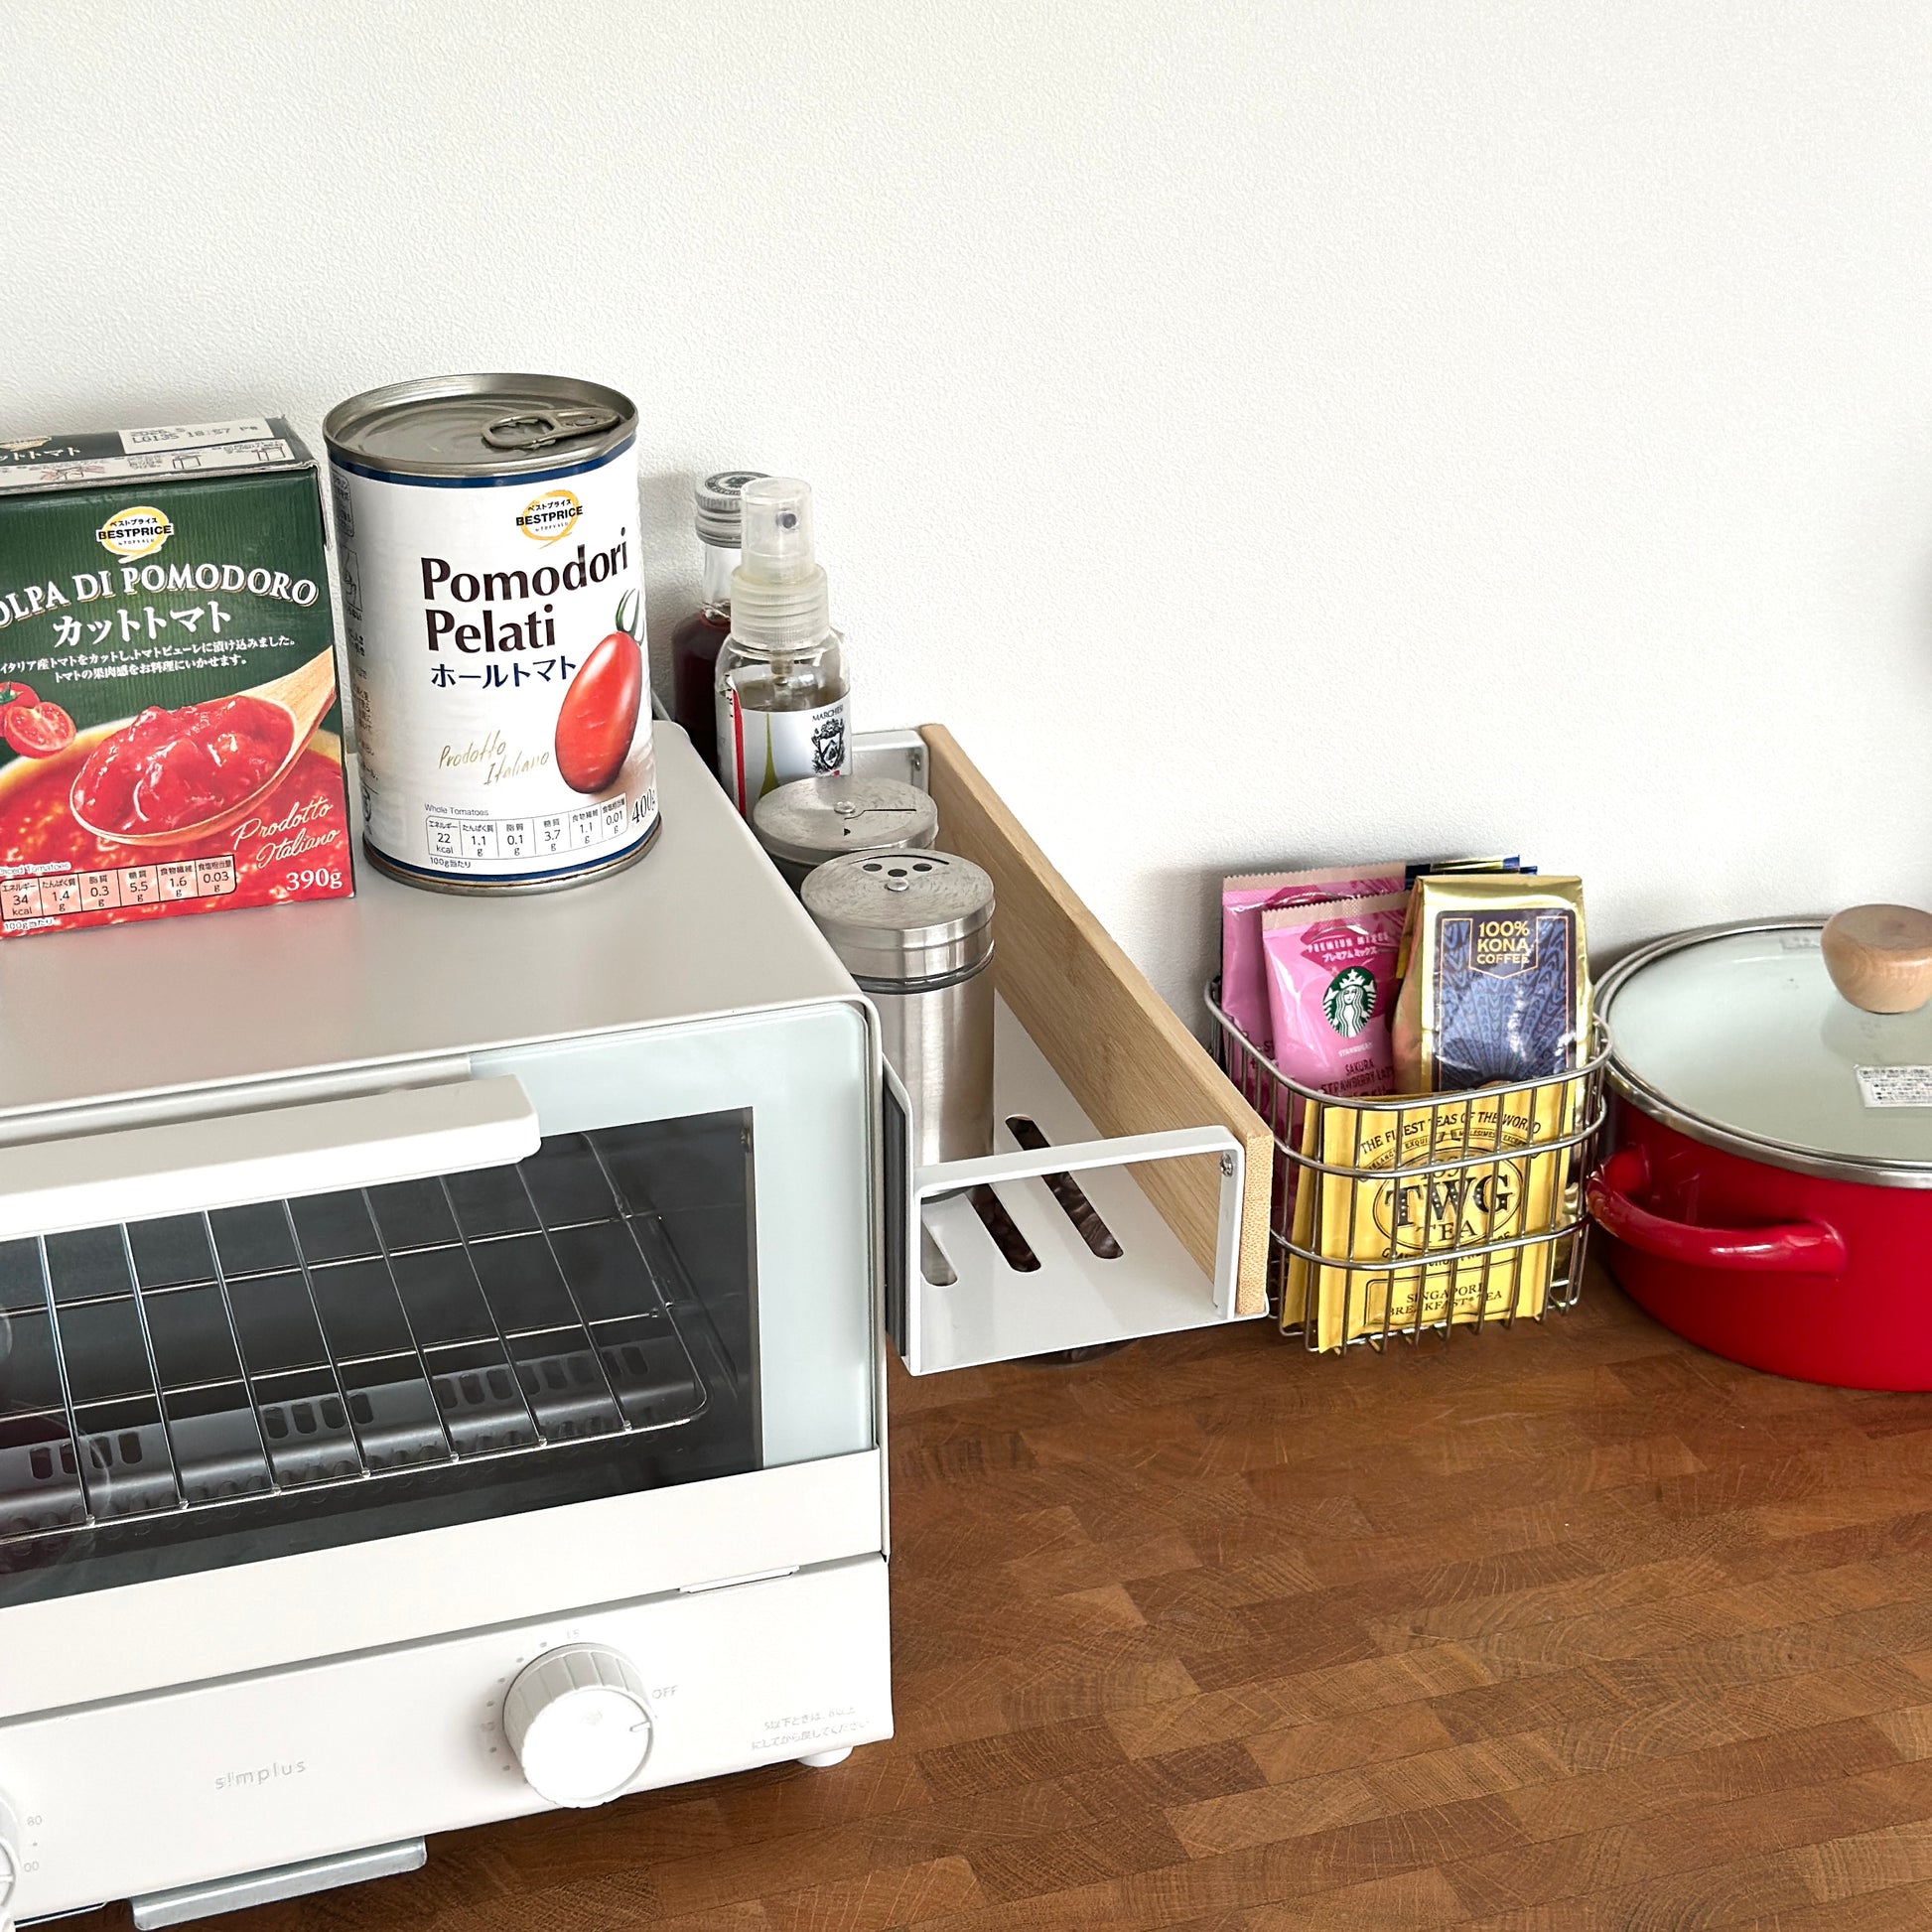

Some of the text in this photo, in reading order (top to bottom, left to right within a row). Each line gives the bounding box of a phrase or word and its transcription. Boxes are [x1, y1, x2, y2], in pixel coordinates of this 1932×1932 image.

[515, 505, 583, 526] BESTPRICE
[98, 525, 172, 540] BESTPRICE
[421, 527, 627, 603] Pomodori
[71, 570, 114, 602] DI
[123, 563, 318, 606] POMODORO
[53, 601, 231, 647] カットトマト
[425, 604, 556, 653] Pelati
[430, 655, 576, 689] ホールトマト
[439, 730, 505, 769] Prodotto
[483, 751, 549, 785] Italiano
[231, 794, 334, 850] Prodotto
[425, 803, 489, 816] Whole Tomatoes
[437, 810, 622, 846] 22 1.1 0.1 3.7 1.1 0.01
[256, 826, 341, 869] Italiano
[436, 845, 454, 854] kcal
[13, 872, 229, 905] 34 1.4 0.3 5.5 1.6 0.03
[42, 878, 75, 889] たんぱく質
[286, 869, 344, 892] 390g
[12, 906, 33, 915] kcal
[137, 894, 143, 902] g
[1477, 937, 1528, 952] KONA
[1478, 920, 1530, 937] 100%
[1476, 953, 1530, 964] COFFEE
[1360, 1135, 1384, 1155] THE
[1478, 1112, 1498, 1124] THE
[1384, 1173, 1515, 1228] TWG
[651, 1685, 678, 1699] OFF
[23, 1861, 40, 1872] 00
